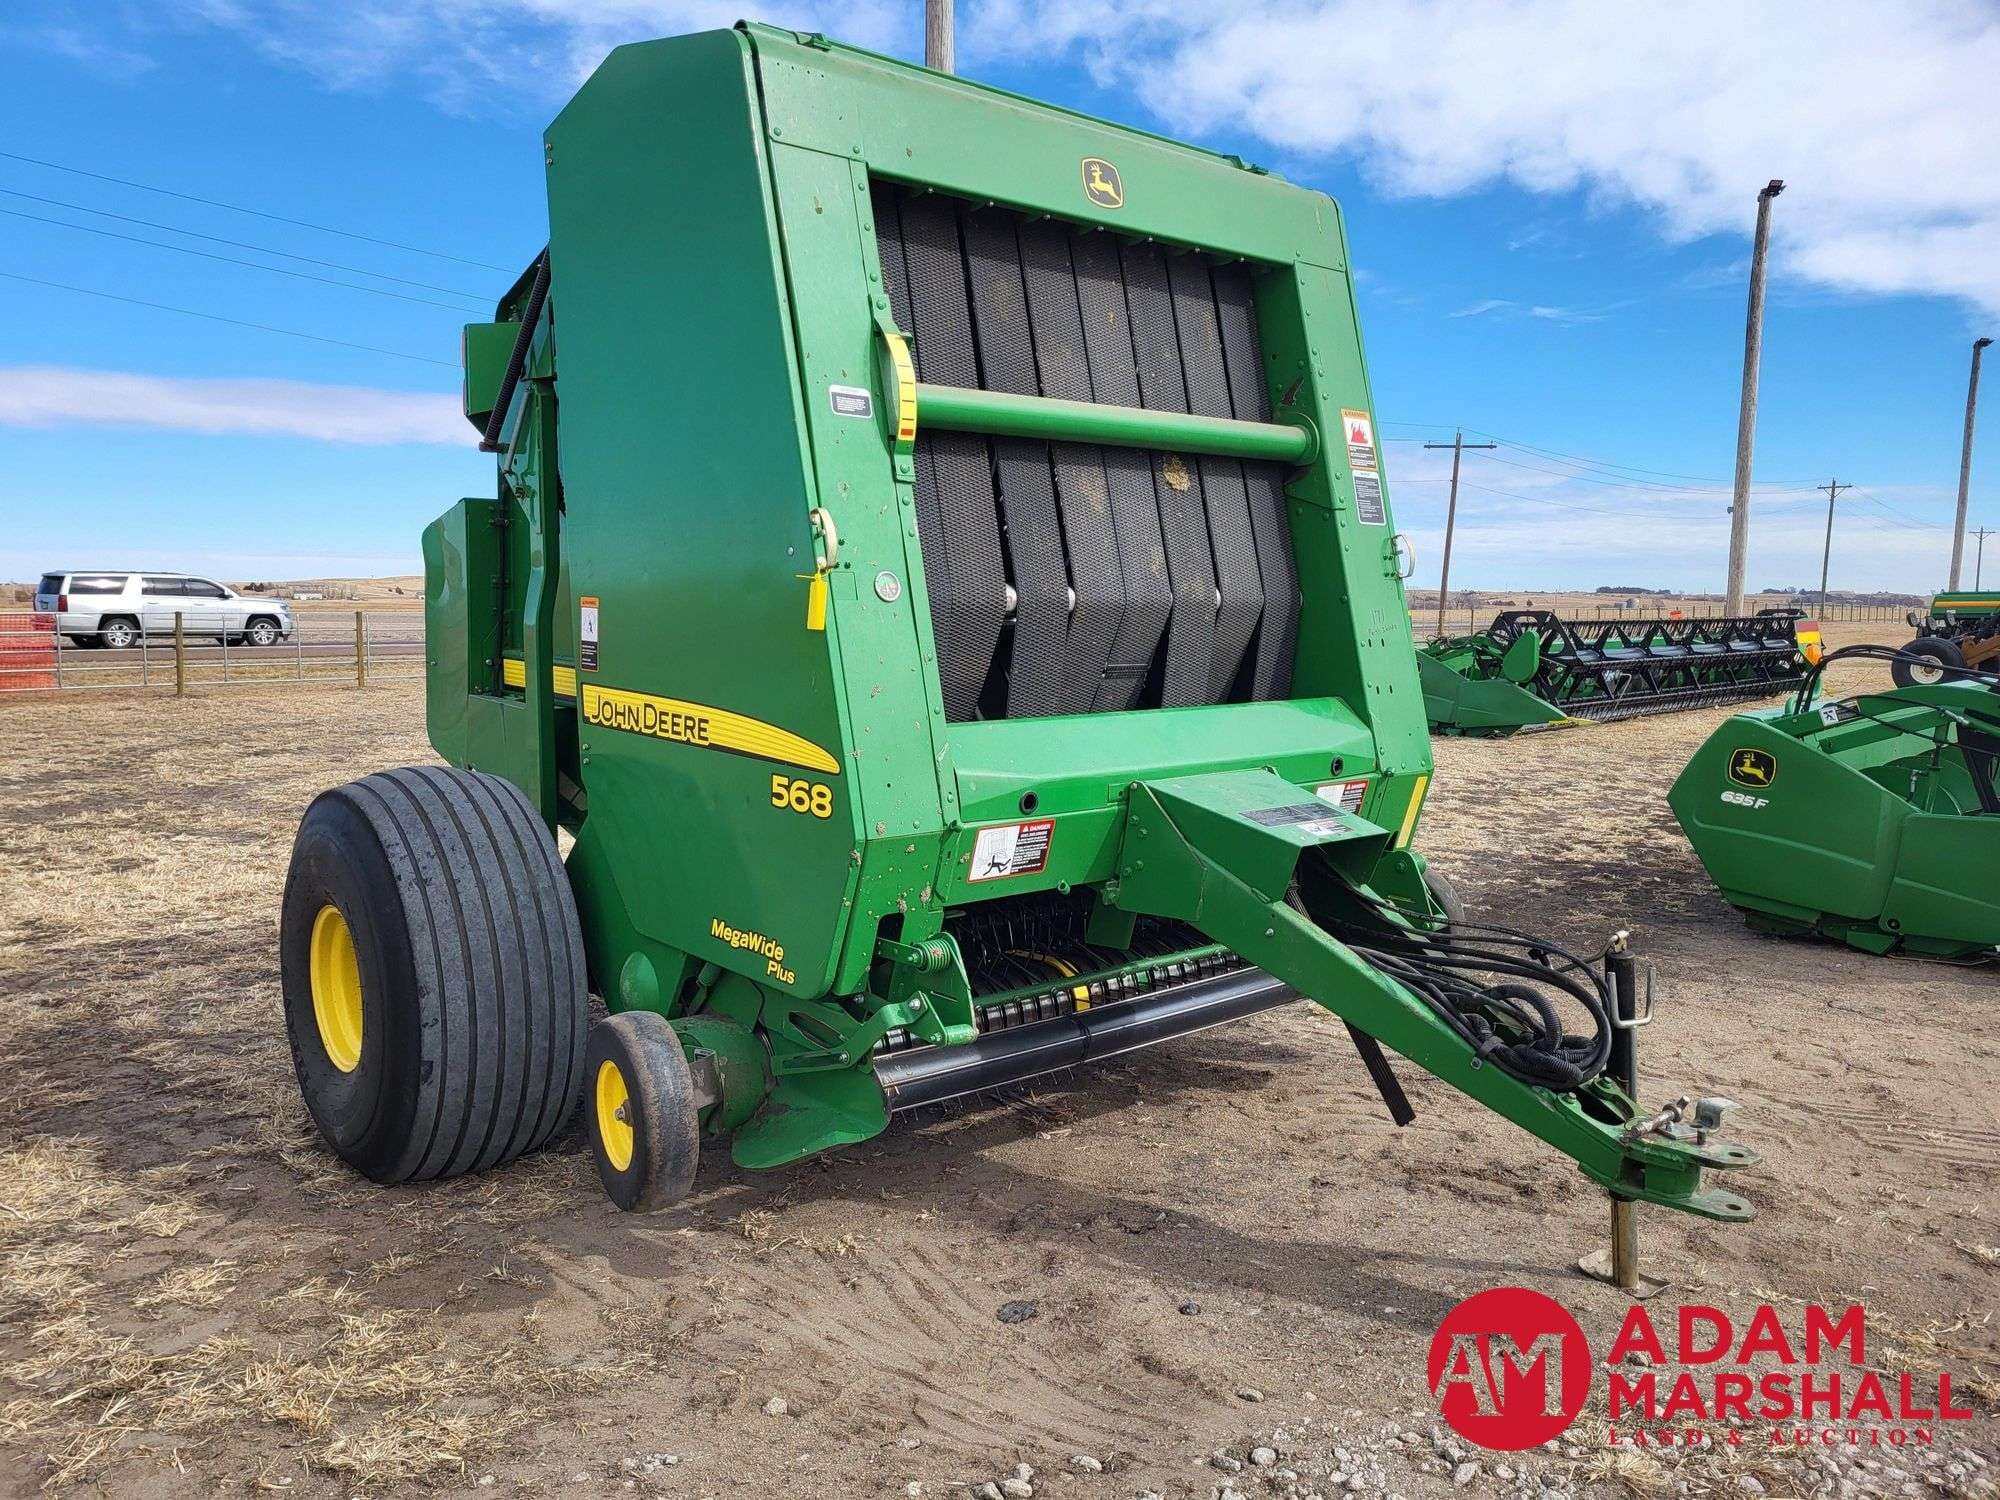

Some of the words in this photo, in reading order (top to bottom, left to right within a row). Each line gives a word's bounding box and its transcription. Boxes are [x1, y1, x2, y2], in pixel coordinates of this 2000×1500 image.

[591, 695, 640, 729] JOHN
[643, 702, 710, 742] DEERE
[771, 775, 833, 819] 568
[1720, 791, 1770, 809] 635F
[711, 917, 785, 962] MegaWide
[767, 960, 796, 985] Plus
